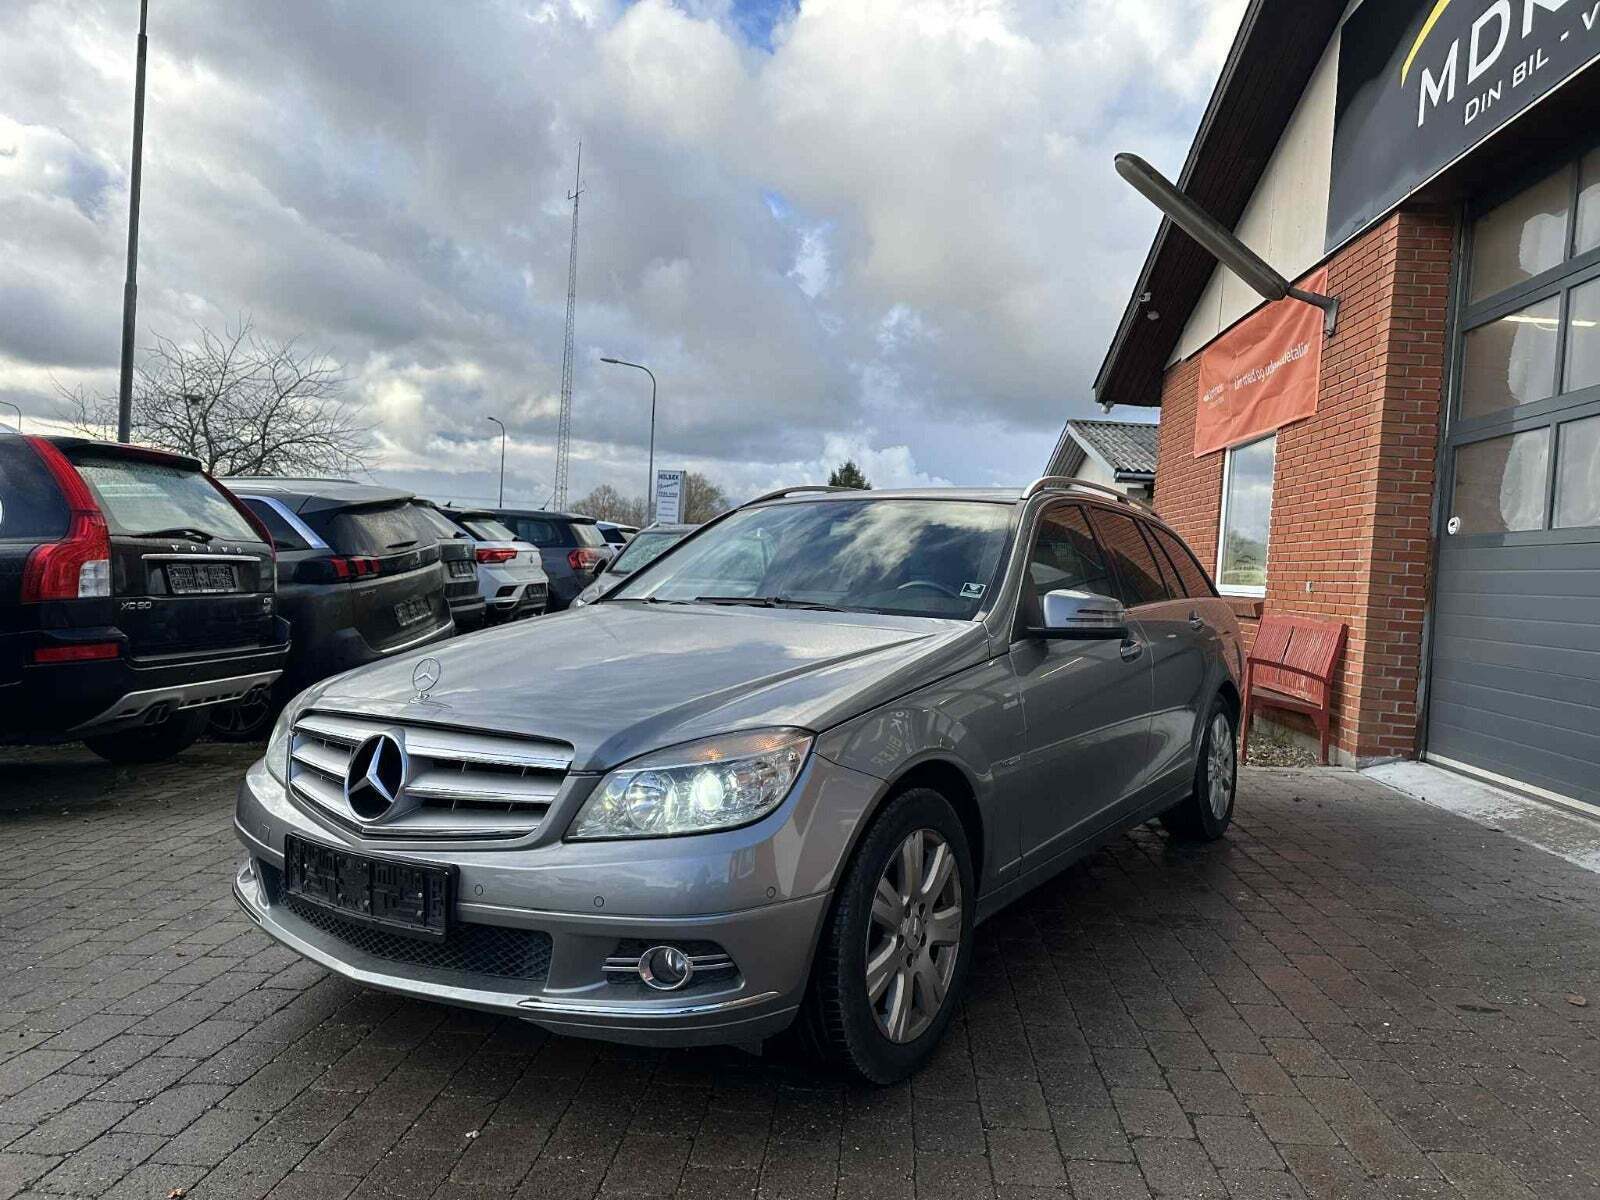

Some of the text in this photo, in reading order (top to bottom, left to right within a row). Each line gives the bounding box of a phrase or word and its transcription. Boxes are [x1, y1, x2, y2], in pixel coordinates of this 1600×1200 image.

[1464, 80, 1502, 126] DIN
[1512, 48, 1550, 88] BIL
[171, 544, 242, 553] VOLVO
[120, 601, 152, 610] XC90
